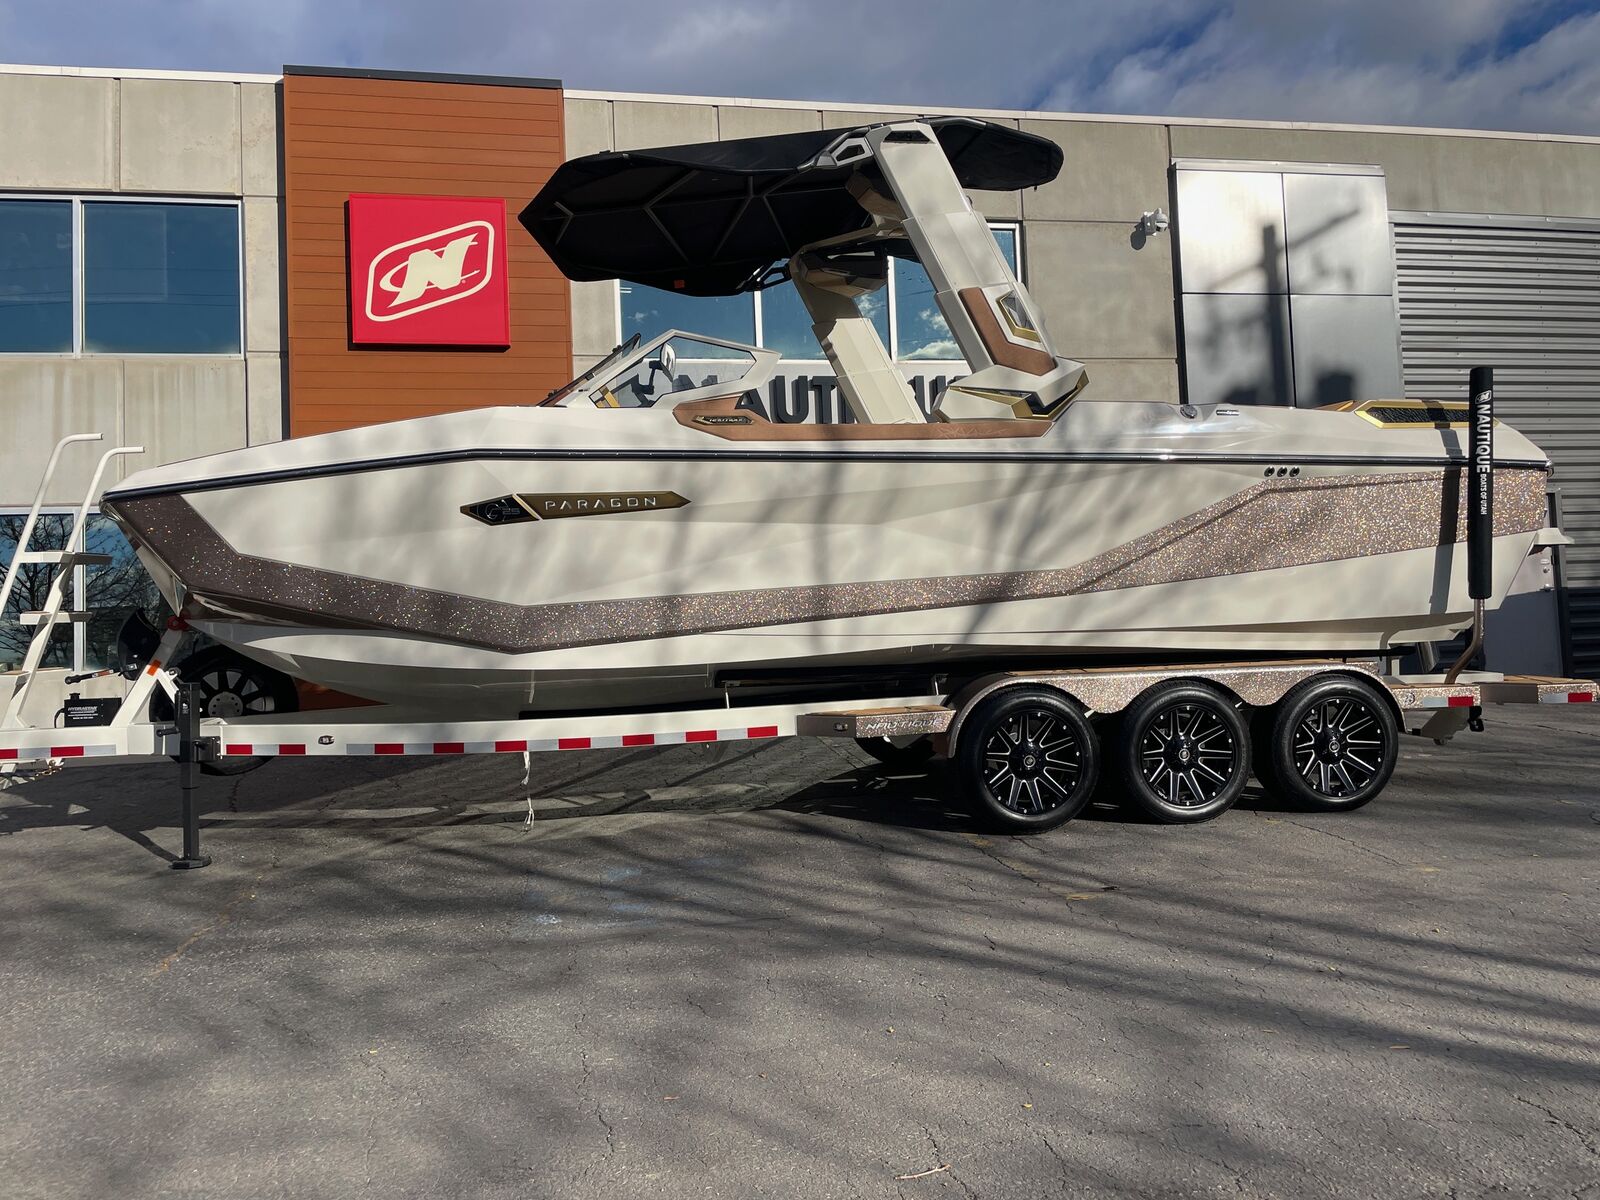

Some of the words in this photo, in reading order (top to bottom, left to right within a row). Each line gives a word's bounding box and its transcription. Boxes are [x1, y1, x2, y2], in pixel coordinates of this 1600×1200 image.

[1476, 404, 1491, 473] NAUTIQUE
[1480, 474, 1488, 491] BOATS
[544, 496, 657, 511] PARAGON
[1480, 500, 1488, 515] UTAH
